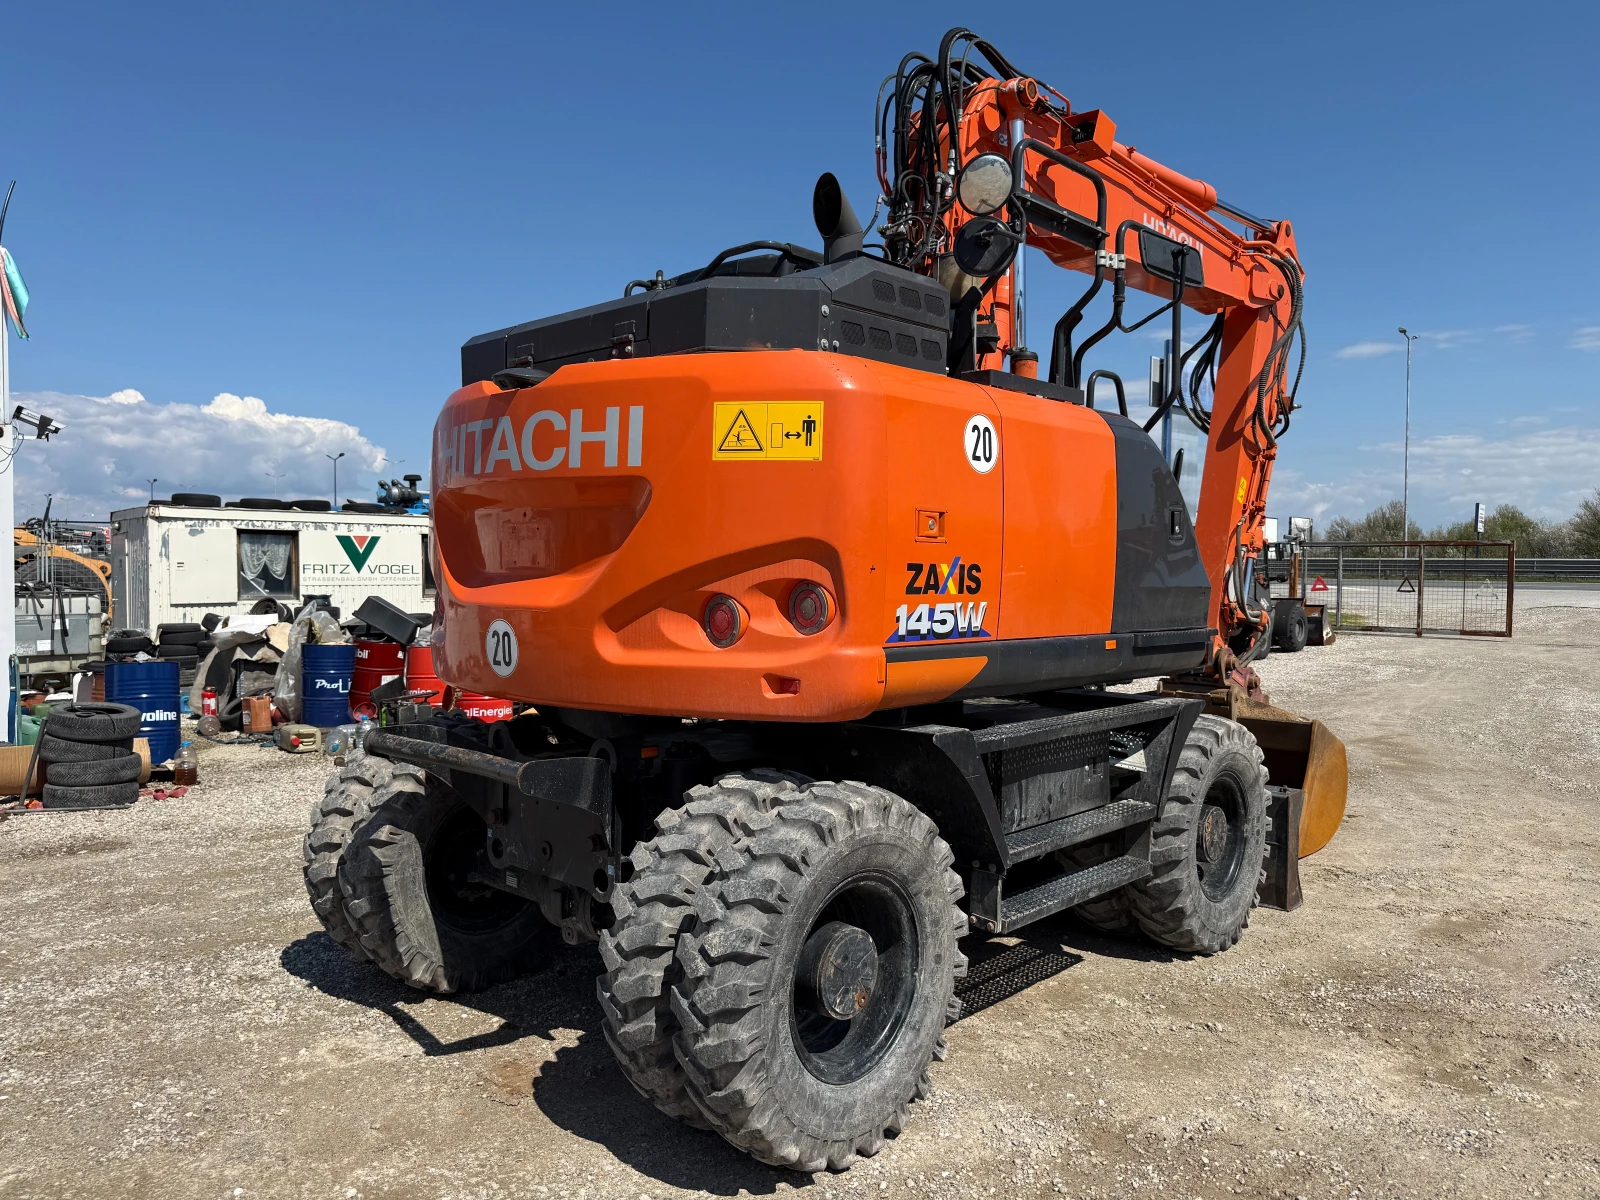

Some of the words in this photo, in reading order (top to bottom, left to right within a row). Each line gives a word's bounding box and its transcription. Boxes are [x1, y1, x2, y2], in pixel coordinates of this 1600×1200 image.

[441, 406, 644, 479] HITACHI
[971, 424, 993, 463] 20
[302, 564, 350, 574] FRITZ
[367, 564, 420, 574] VOGEL
[905, 556, 982, 595] ZAXIS
[896, 602, 987, 641] 145W
[355, 648, 369, 660] bil
[491, 630, 512, 667] 20
[315, 678, 352, 693] ProLi
[141, 709, 177, 722] voline
[464, 705, 512, 718] alEnergies
